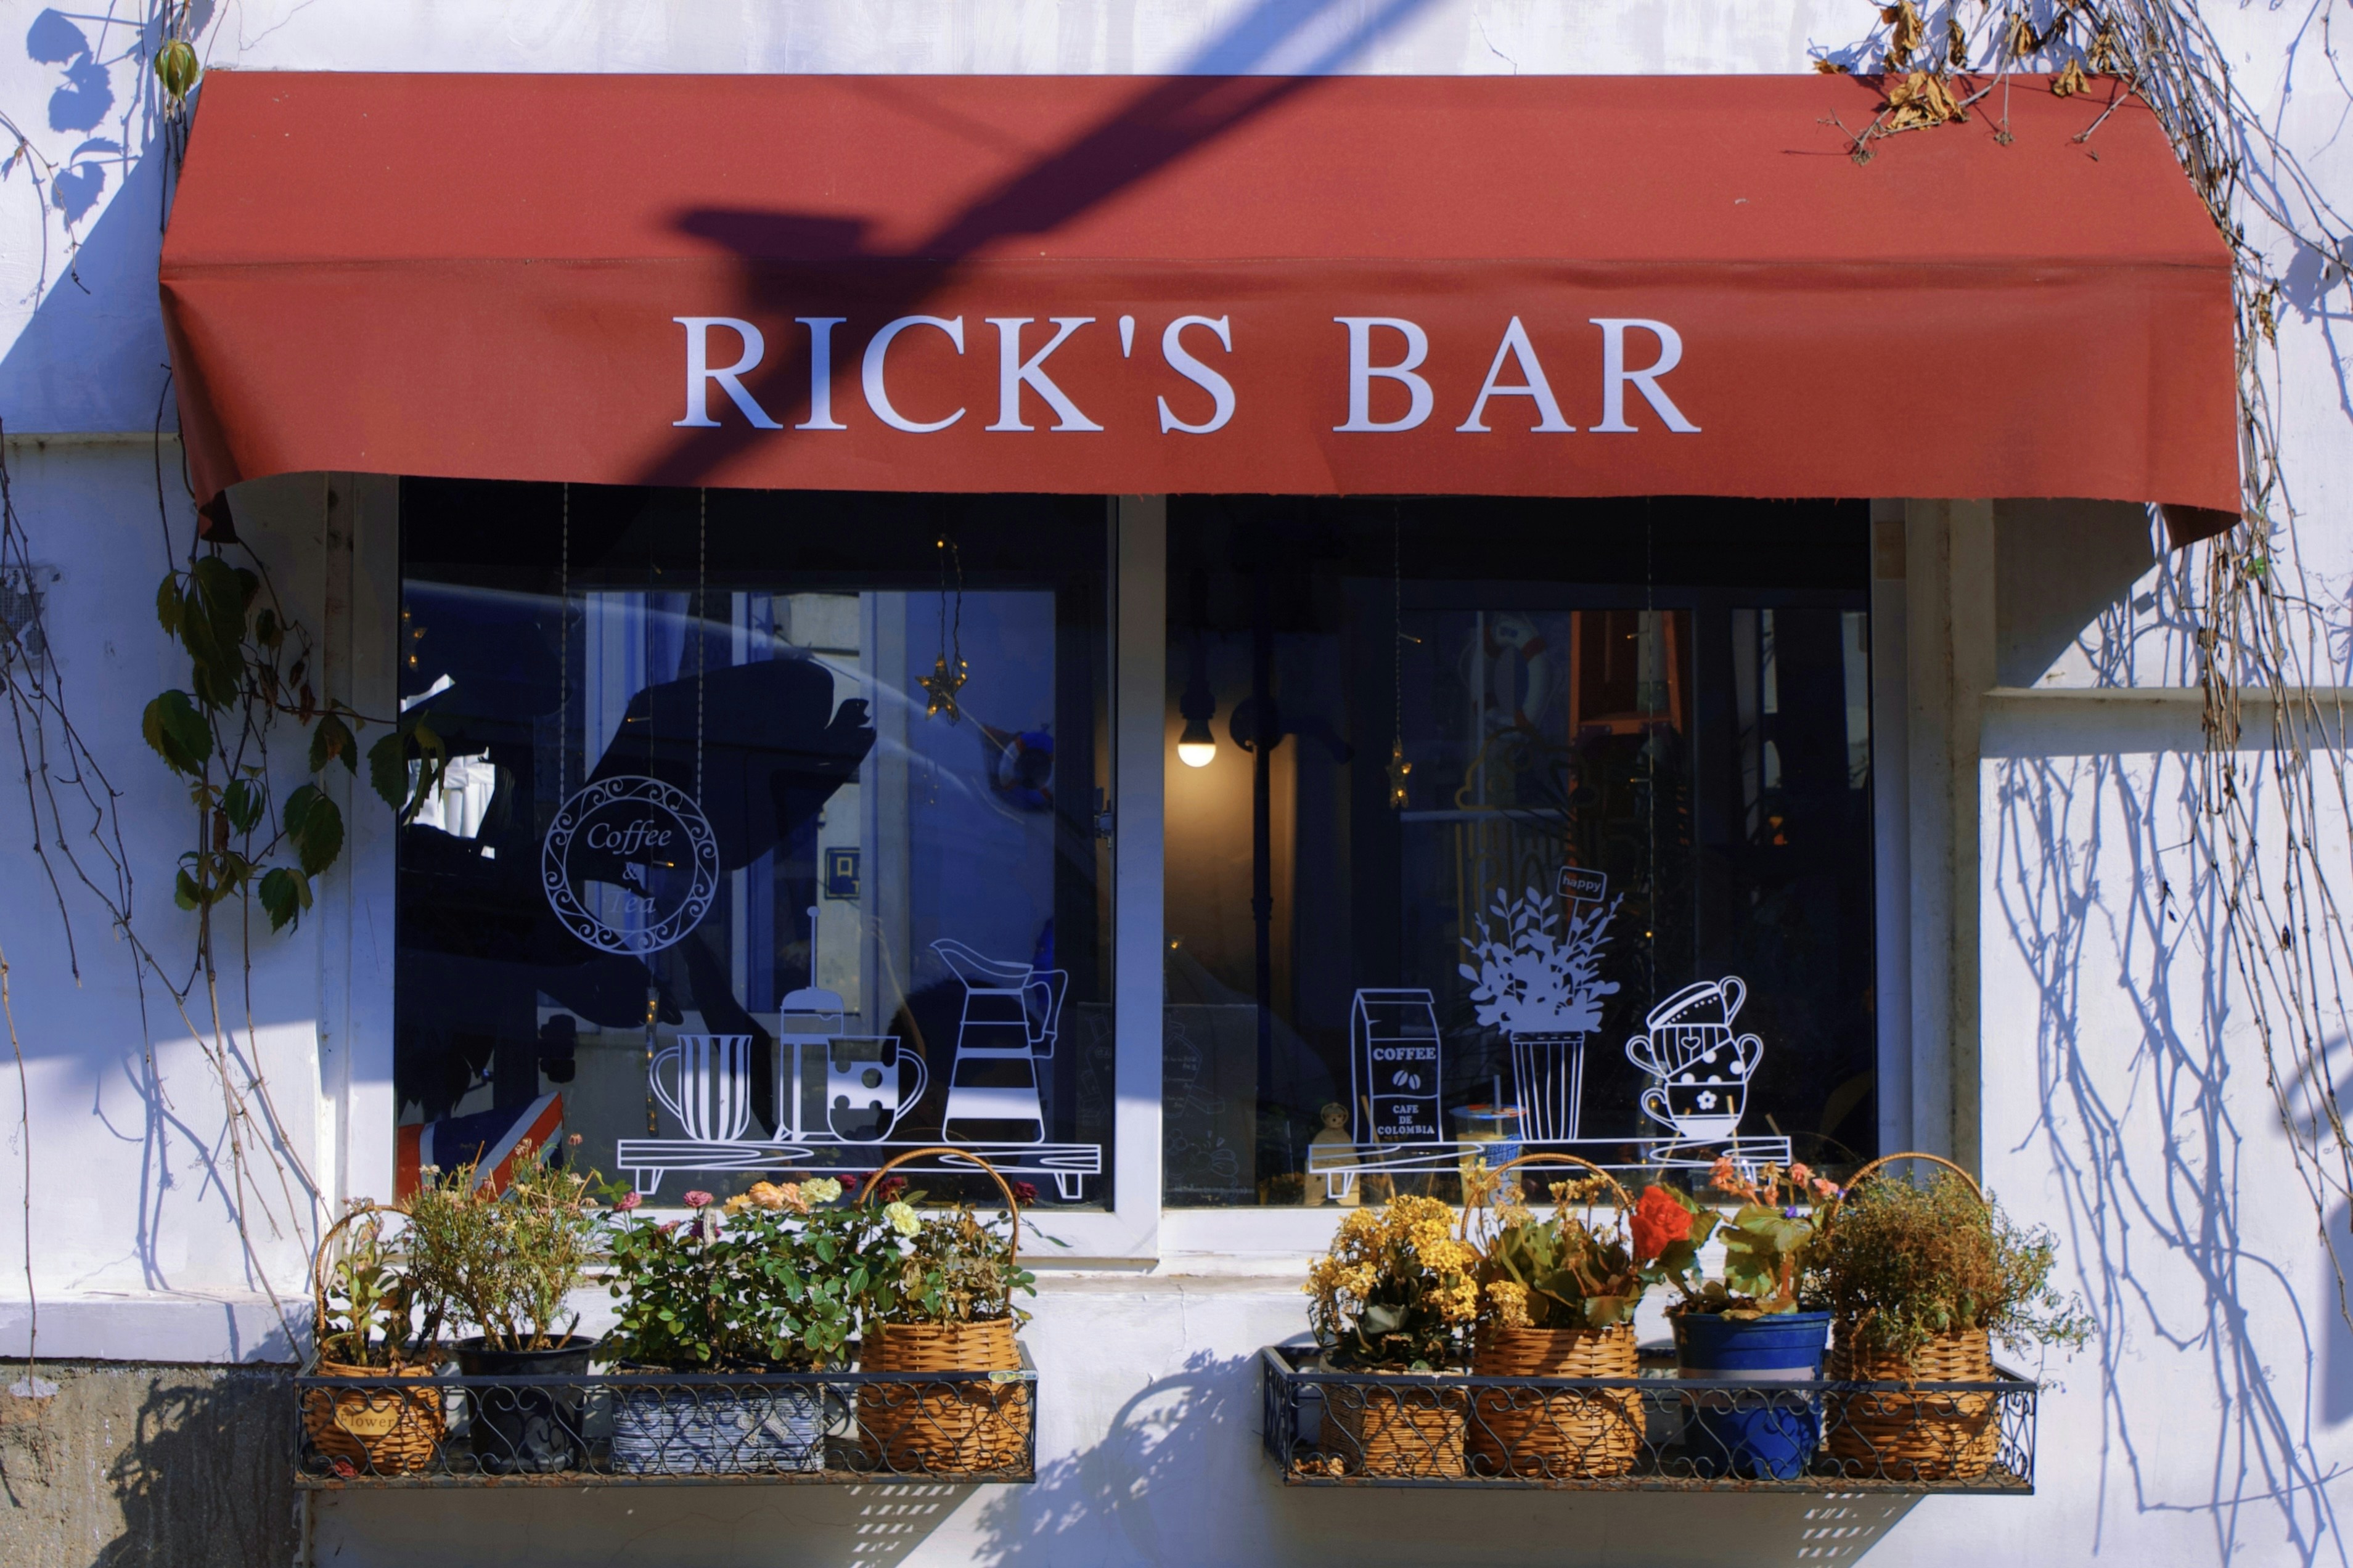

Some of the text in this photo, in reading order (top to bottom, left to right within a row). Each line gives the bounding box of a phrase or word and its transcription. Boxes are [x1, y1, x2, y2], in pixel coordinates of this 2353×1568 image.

[672, 314, 1702, 434] RICK'S BAR
[587, 820, 671, 854] Coffee
[1562, 875, 1602, 892] happy
[608, 888, 657, 913] Tea
[1373, 1047, 1436, 1061] COFFEE
[1393, 1105, 1419, 1114] CAFE
[1399, 1116, 1412, 1125] DE
[1377, 1125, 1435, 1135] COLOMBIA
[340, 1413, 395, 1427] Flower
